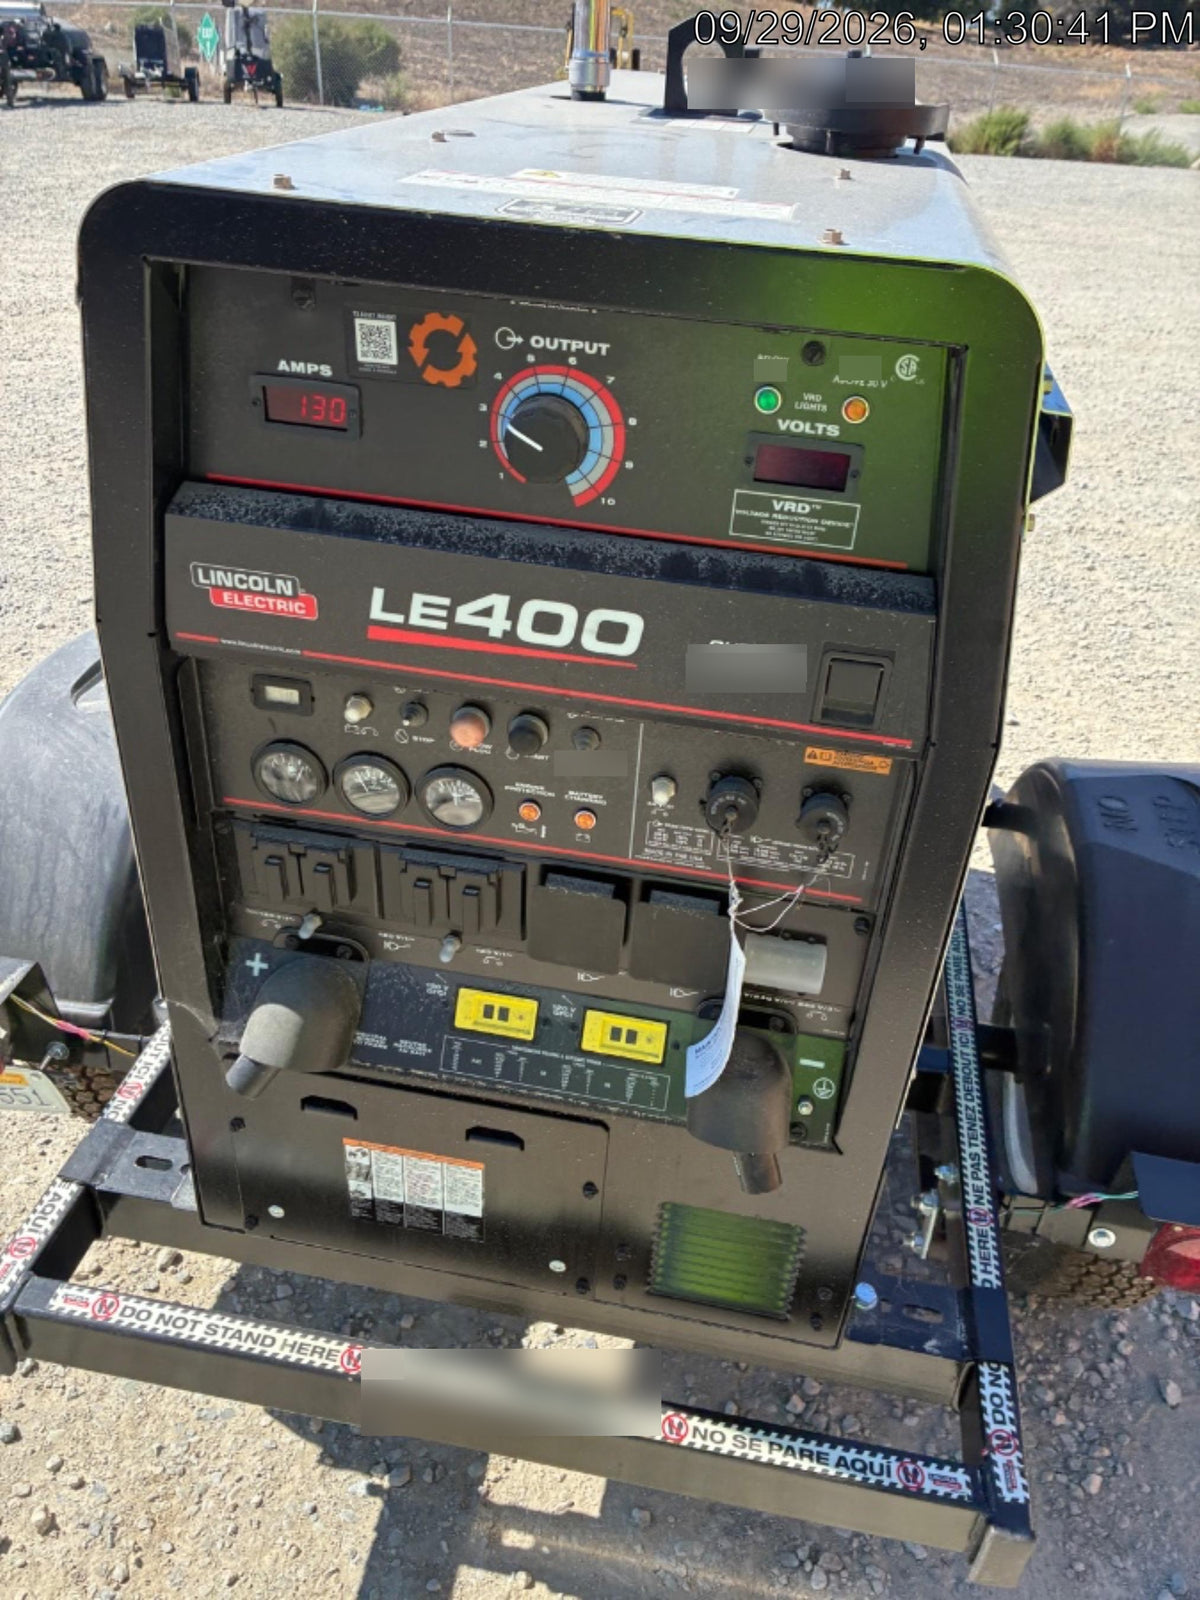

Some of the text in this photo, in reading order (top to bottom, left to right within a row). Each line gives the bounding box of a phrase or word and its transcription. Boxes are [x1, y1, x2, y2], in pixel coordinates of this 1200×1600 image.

[530, 335, 611, 356] OUTPUT
[278, 358, 333, 378] AMPS
[526, 354, 536, 363] 5
[568, 357, 577, 366] 6
[493, 372, 503, 380] 4
[606, 376, 615, 385] 7
[300, 394, 347, 425] 130
[777, 419, 840, 437] VOLTS
[479, 440, 488, 448] 2
[601, 497, 616, 506] 10
[197, 567, 293, 597] LINCOLN
[222, 591, 306, 615] ELECTRIC
[369, 587, 645, 657] LE400
[957, 1032, 986, 1206] NE PAS TENEZ DEBOUT ICI
[976, 1228, 993, 1275] HERE
[120, 1305, 341, 1362] DO NOT STAND HERE
[989, 1391, 1007, 1425] DO
[692, 1424, 892, 1479] NO SE PARE AQUÍ
